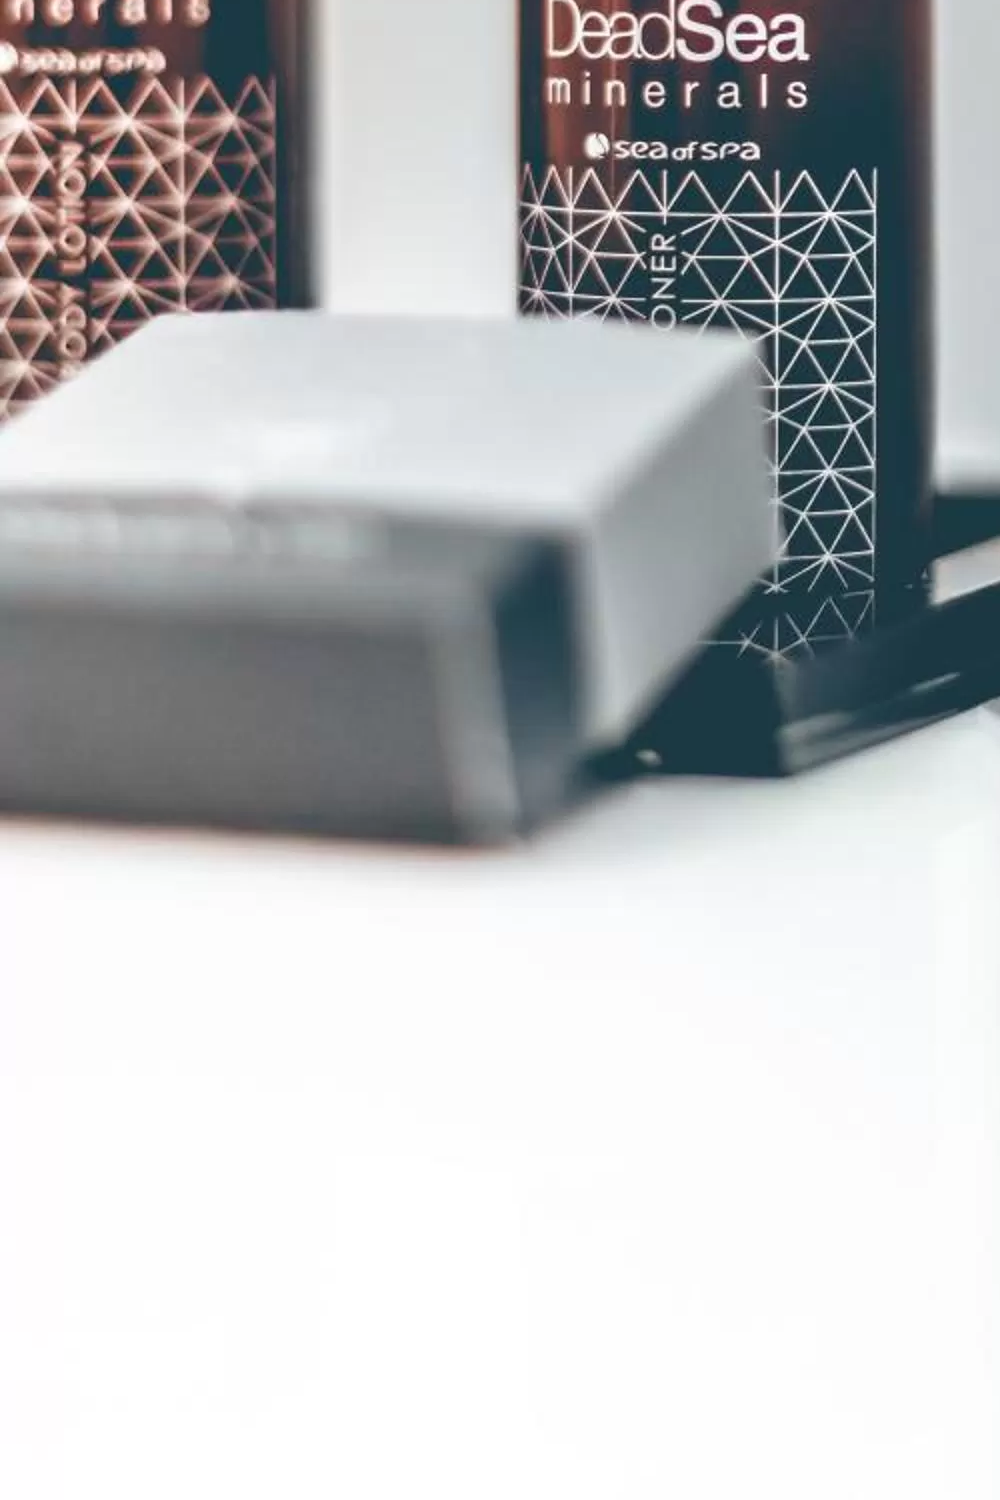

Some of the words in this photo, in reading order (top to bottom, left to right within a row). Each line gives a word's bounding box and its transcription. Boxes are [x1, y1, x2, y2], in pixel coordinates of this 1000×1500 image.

[548, 72, 808, 108] minerals
[614, 140, 668, 160] sea
[671, 141, 698, 161] of
[57, 140, 87, 272] LOTION
